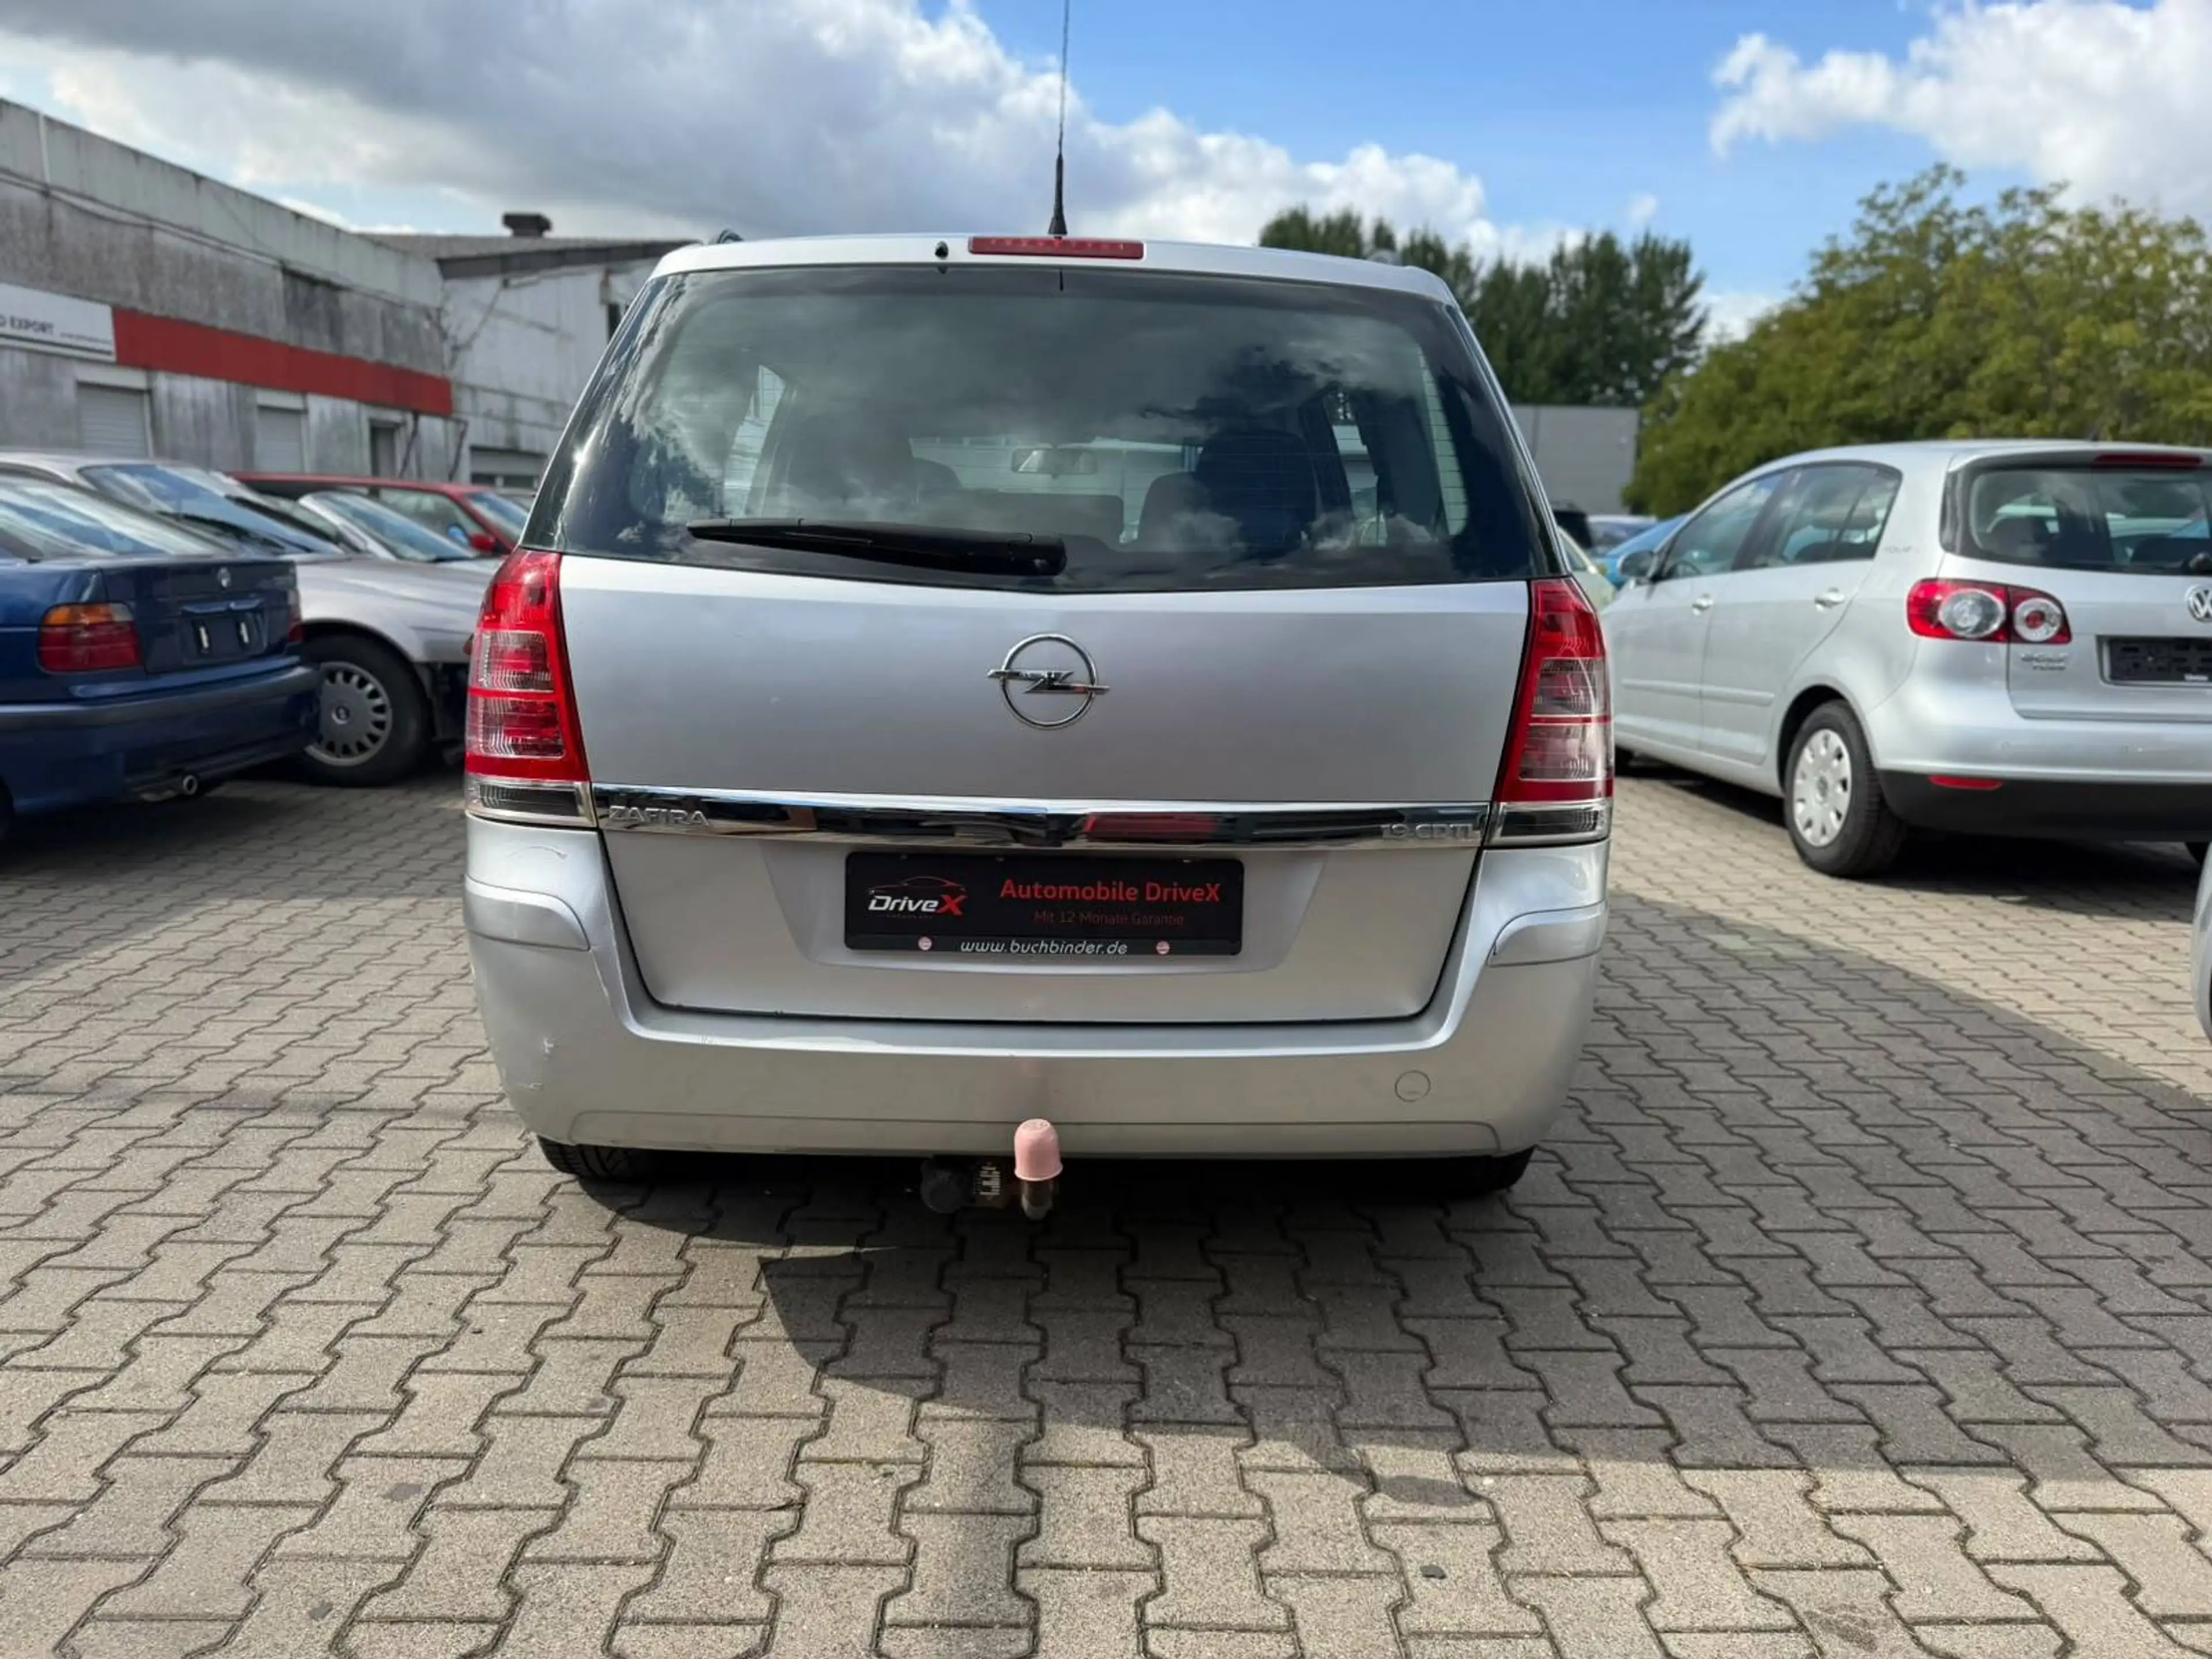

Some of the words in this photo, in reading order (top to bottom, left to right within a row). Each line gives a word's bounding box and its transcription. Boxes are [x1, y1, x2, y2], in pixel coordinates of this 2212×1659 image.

[609, 805, 709, 826] ZAFIRA
[1000, 878, 1139, 902] Automobile
[1145, 882, 1221, 903] DriveX
[868, 895, 968, 916] DriveX
[1033, 910, 1054, 923] Mit
[1060, 911, 1075, 923] 12
[1079, 911, 1128, 925] Monate
[1131, 912, 1184, 926] Garantie
[960, 938, 1128, 955] www.buchbinder.de
